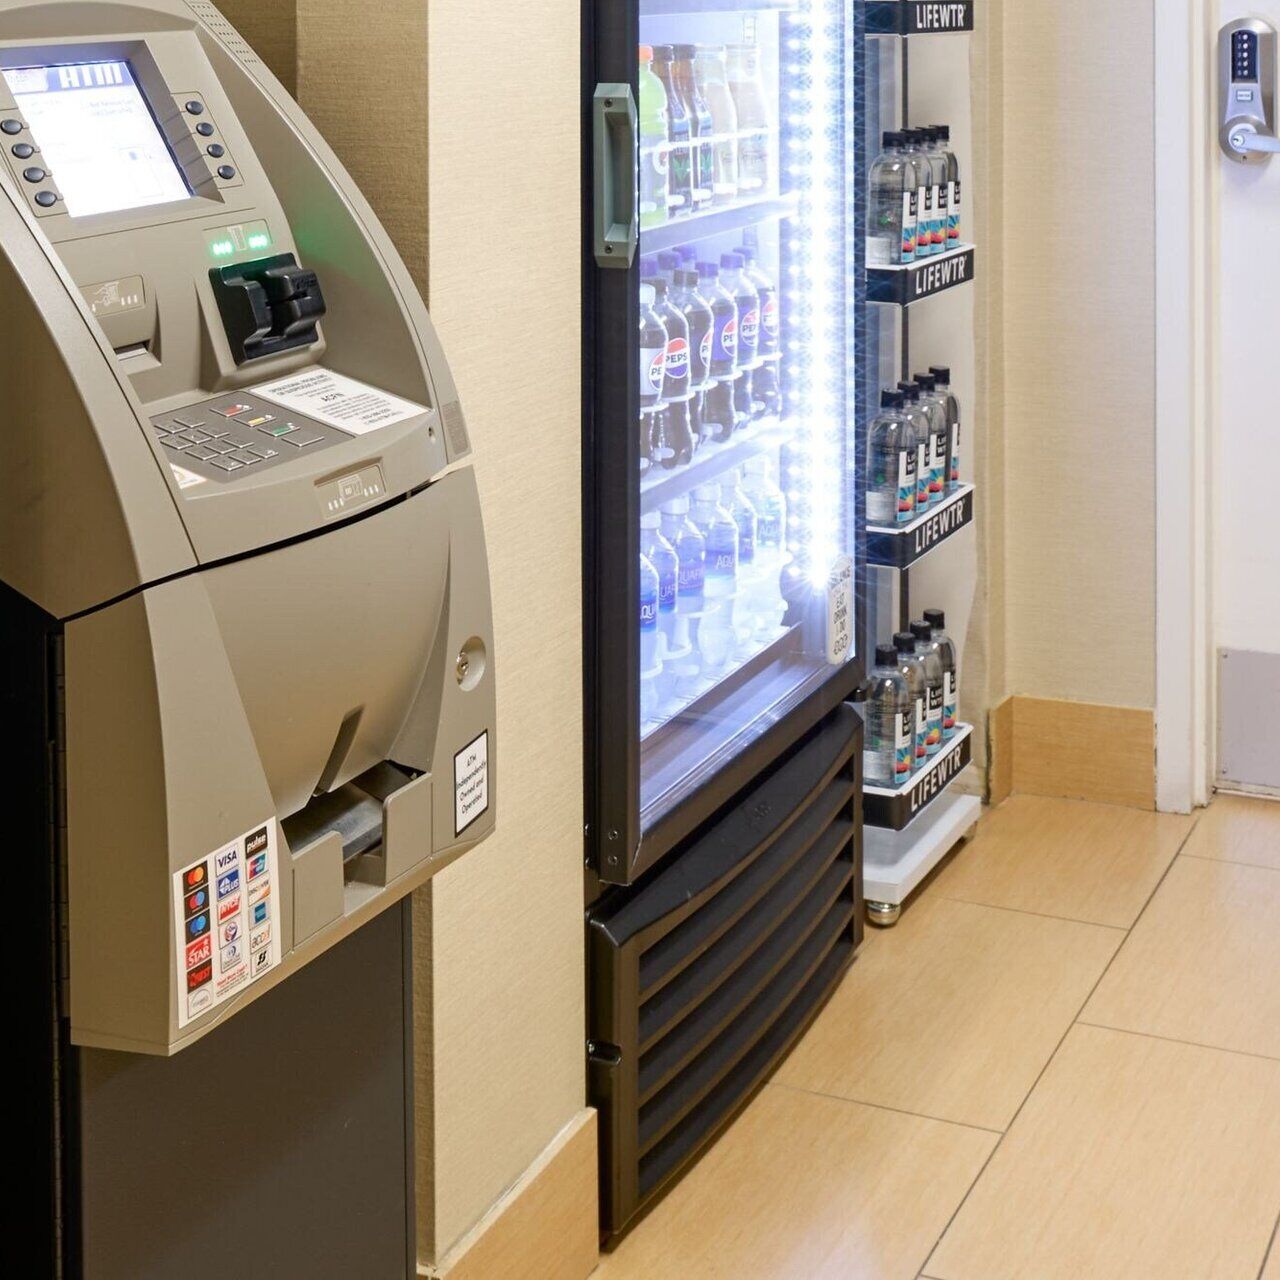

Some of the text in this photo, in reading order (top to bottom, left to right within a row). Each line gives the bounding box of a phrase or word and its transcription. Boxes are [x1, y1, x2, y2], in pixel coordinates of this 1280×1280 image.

[916, 4, 964, 29] LIFEWTR
[58, 64, 123, 89] ATM
[915, 257, 965, 294] LIFEWTR
[665, 352, 687, 363] PEPS
[915, 500, 963, 553] LIFEWTR
[911, 747, 961, 812] LIFEWTR
[218, 850, 237, 868] VISA
[188, 946, 210, 967] STAR
